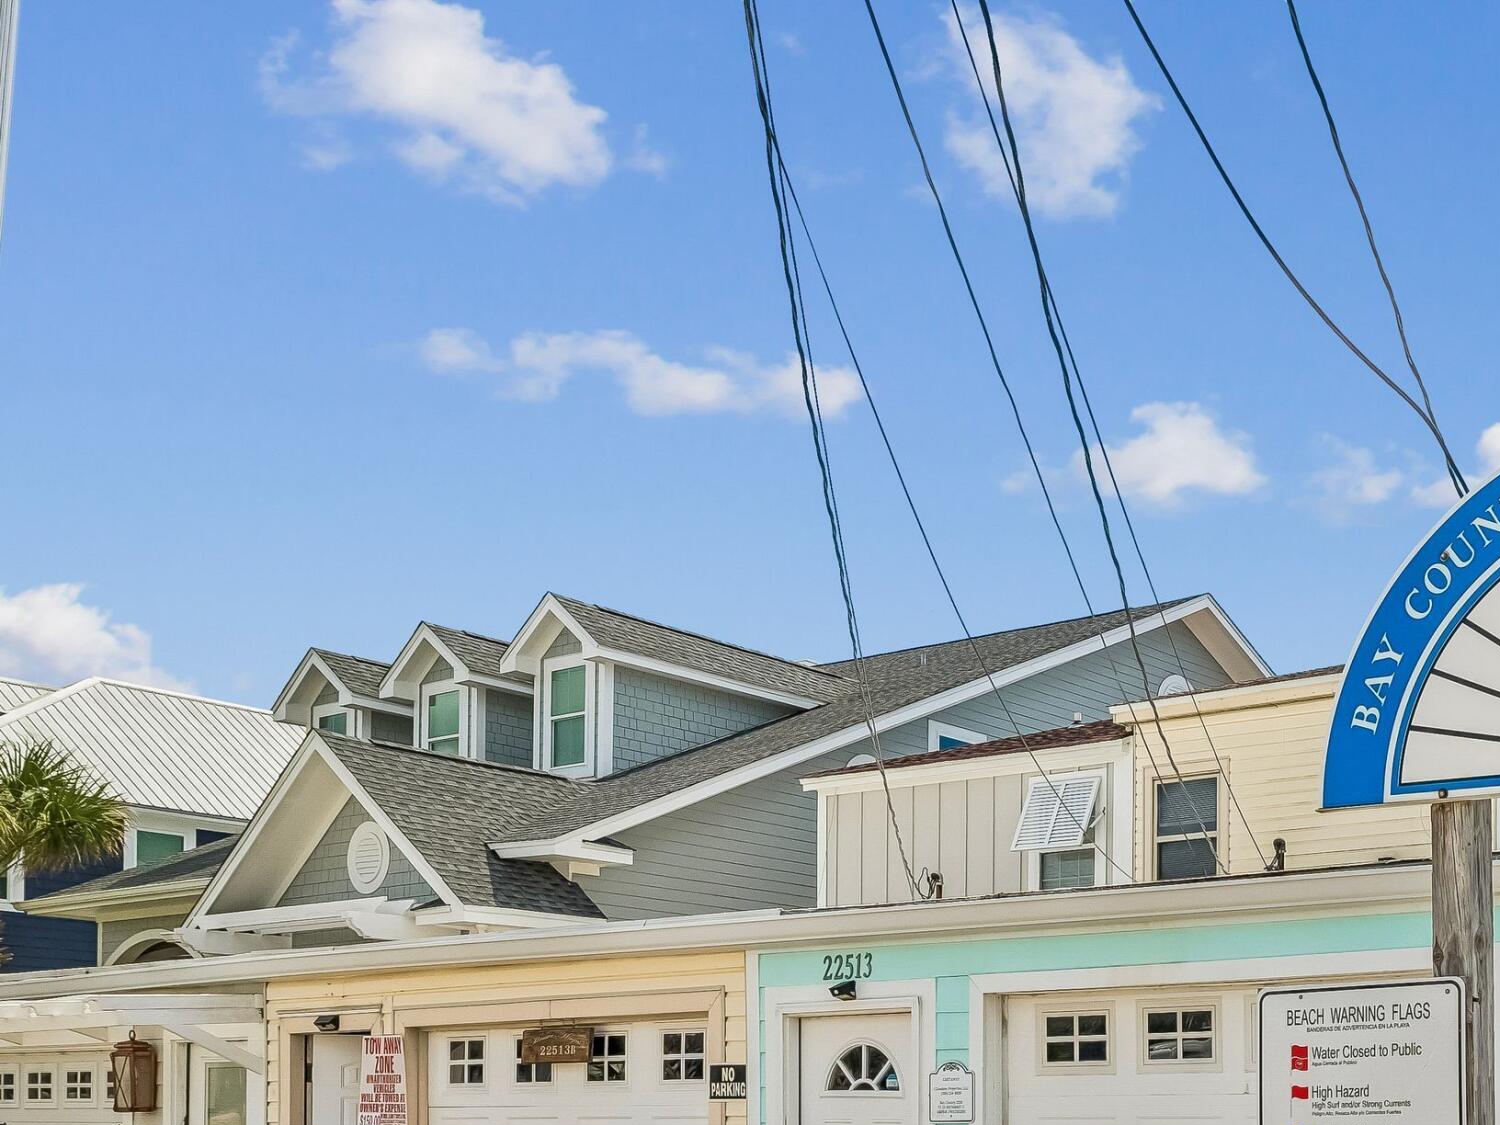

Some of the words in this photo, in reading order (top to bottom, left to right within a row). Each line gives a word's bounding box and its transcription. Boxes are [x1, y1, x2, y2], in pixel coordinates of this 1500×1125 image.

[1352, 637, 1404, 735] BAY
[823, 952, 872, 980] 22513
[1287, 1008, 1324, 1026] BEACH
[1330, 1005, 1385, 1024] WARNING
[1391, 1002, 1431, 1020] FLAGS
[364, 1038, 381, 1054] TOW
[383, 1037, 402, 1054] AWAY
[540, 1044, 576, 1056] 22513B
[1312, 1046, 1340, 1059] Water
[1342, 1044, 1376, 1058] Closed
[1378, 1044, 1388, 1057] to
[1391, 1042, 1422, 1056] Public
[375, 1056, 394, 1074] ZONE
[721, 1067, 735, 1081] NO
[711, 1082, 746, 1097] PARKING
[1312, 1085, 1332, 1102] High
[1335, 1084, 1370, 1098] Hazard
[1312, 1102, 1326, 1110] High
[1361, 1100, 1382, 1110] Strong
